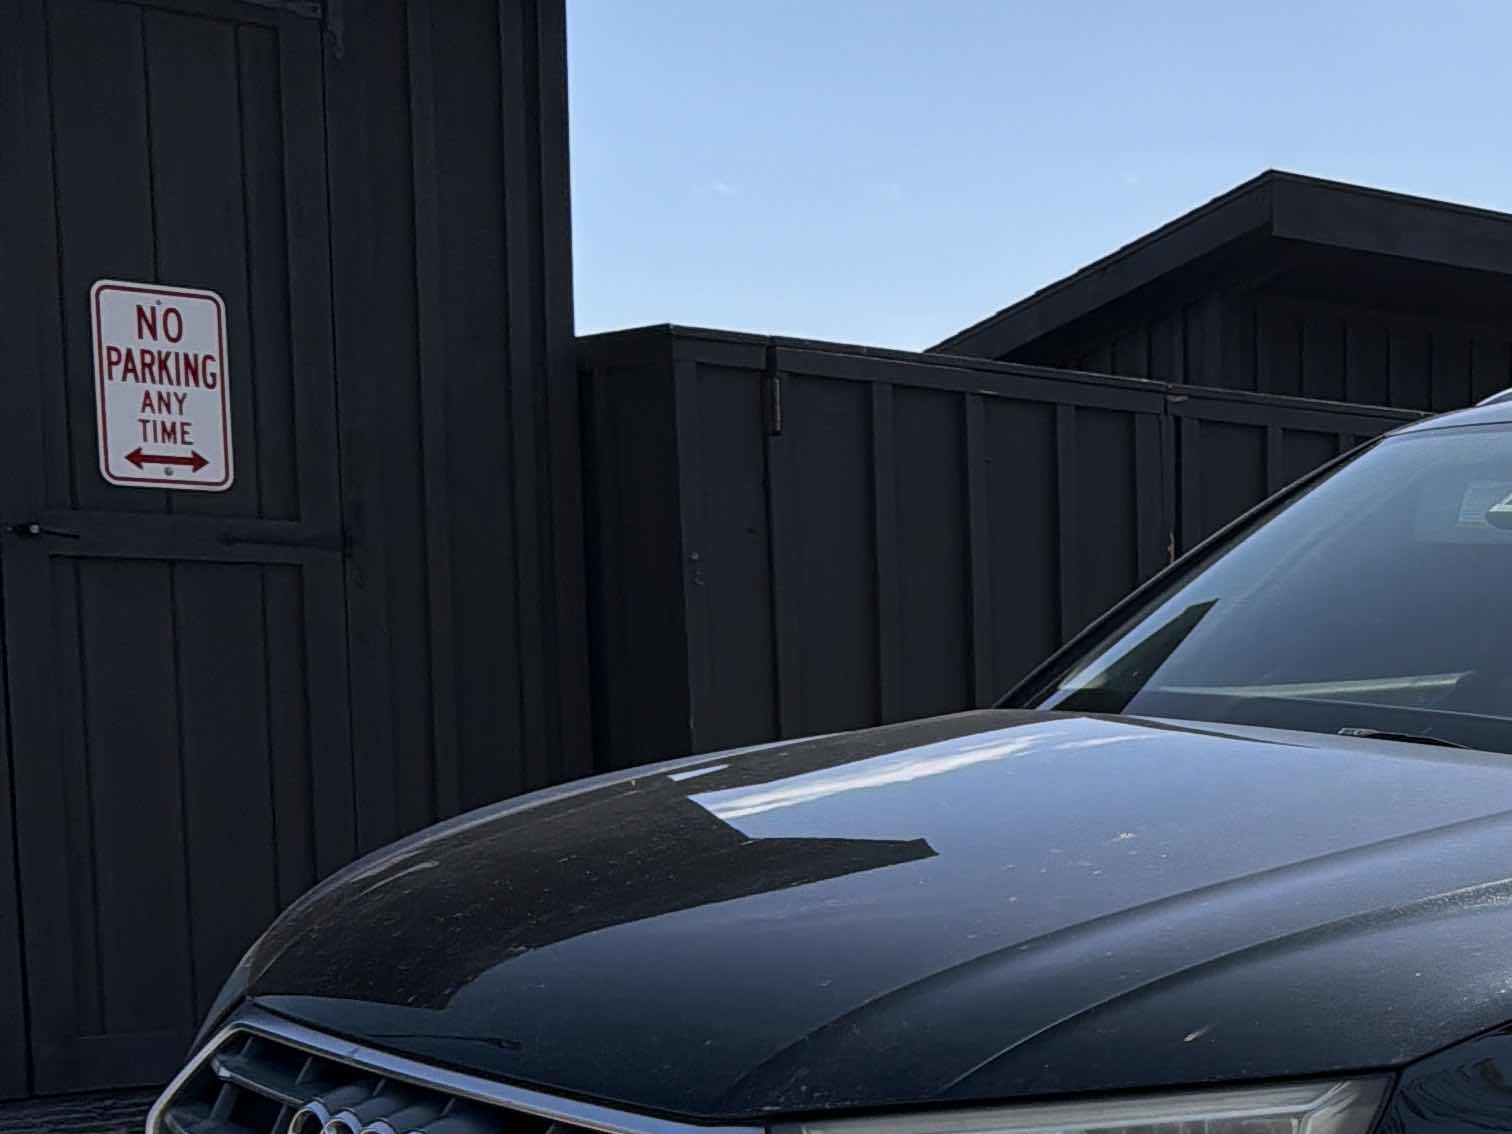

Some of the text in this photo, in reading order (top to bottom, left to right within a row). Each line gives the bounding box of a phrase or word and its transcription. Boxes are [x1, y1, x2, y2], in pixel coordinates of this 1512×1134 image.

[136, 304, 183, 343] NO
[106, 346, 217, 390] PARKING
[140, 390, 187, 416] ANY
[138, 419, 194, 445] TIME
